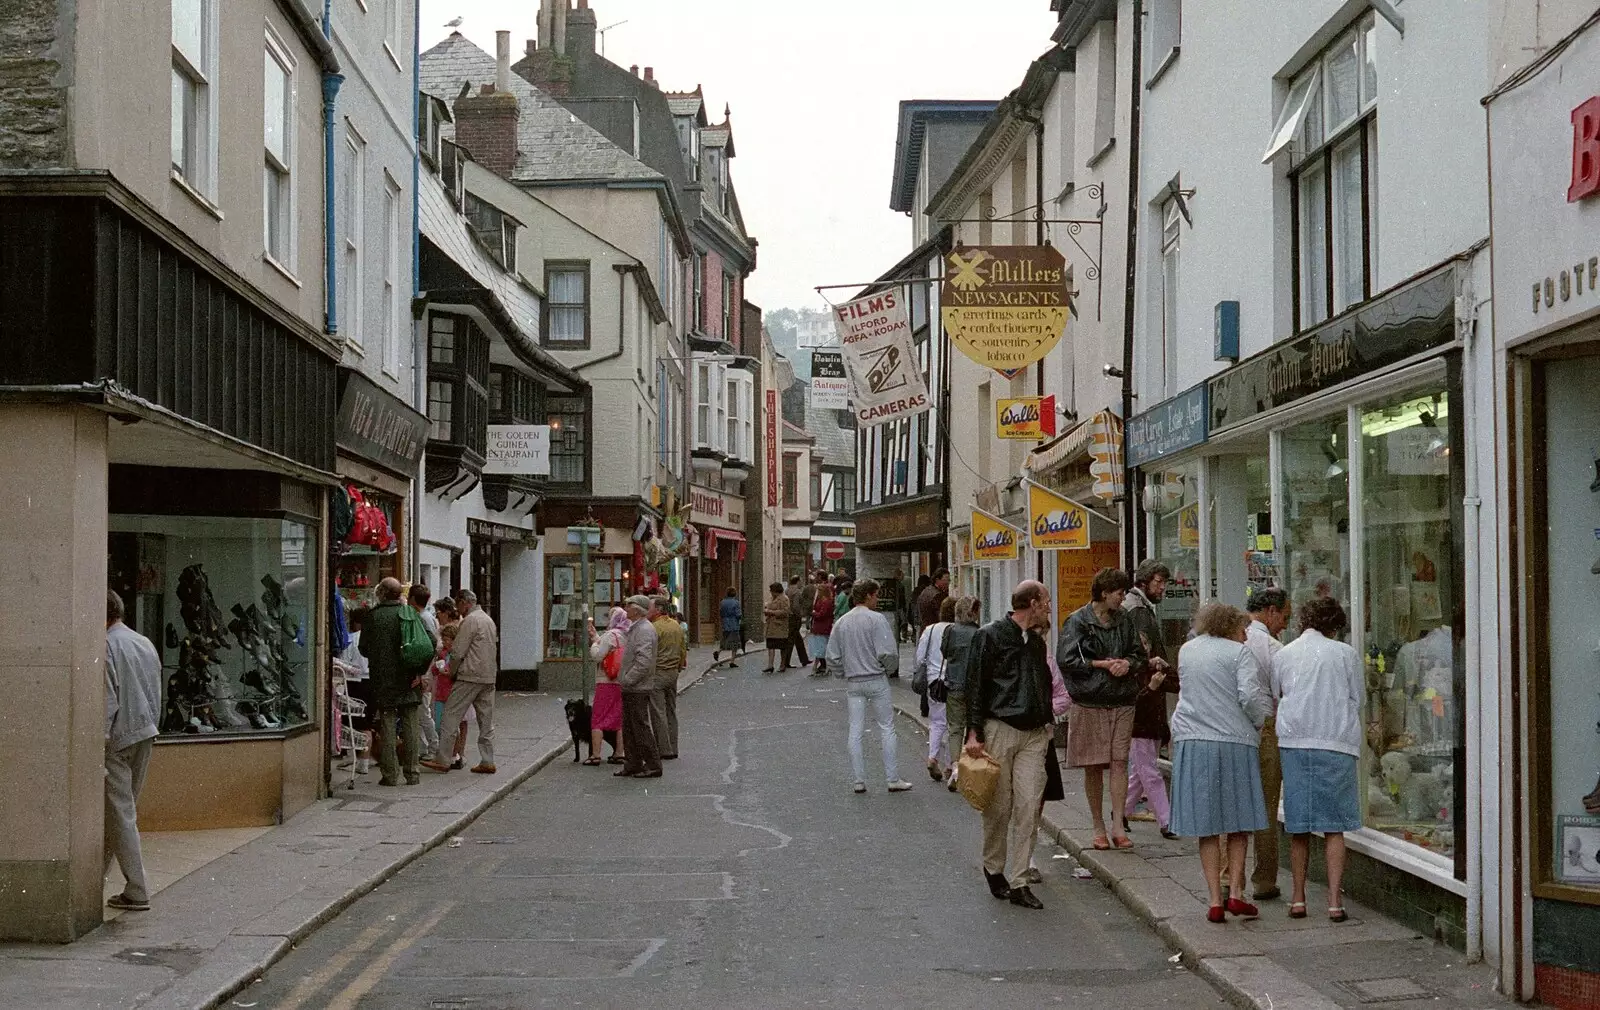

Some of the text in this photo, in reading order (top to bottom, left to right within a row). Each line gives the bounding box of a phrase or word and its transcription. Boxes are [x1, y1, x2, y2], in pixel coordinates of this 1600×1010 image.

[989, 259, 1061, 286] Millers
[952, 291, 1060, 305] NEWSAGENTS
[837, 292, 896, 322] FILMS
[963, 308, 1047, 321] greetings cards
[851, 316, 888, 333] ILFORD
[970, 323, 1042, 335] confectionery
[843, 320, 907, 345] AGFA KODAK
[982, 337, 1030, 347] souvenirs
[814, 354, 842, 363] Dowlin
[987, 351, 1025, 361] tobacco
[814, 380, 847, 390] Antiques
[859, 393, 926, 421] CAMERAS
[1000, 404, 1039, 427] Wall's
[487, 431, 540, 440] THE GOLDEN
[496, 440, 529, 449] GUINEA
[767, 392, 777, 504] THE SHIP INN
[488, 450, 541, 459] ESTAURANT
[1033, 508, 1083, 537] Wall's
[975, 528, 1014, 551] Wall's
